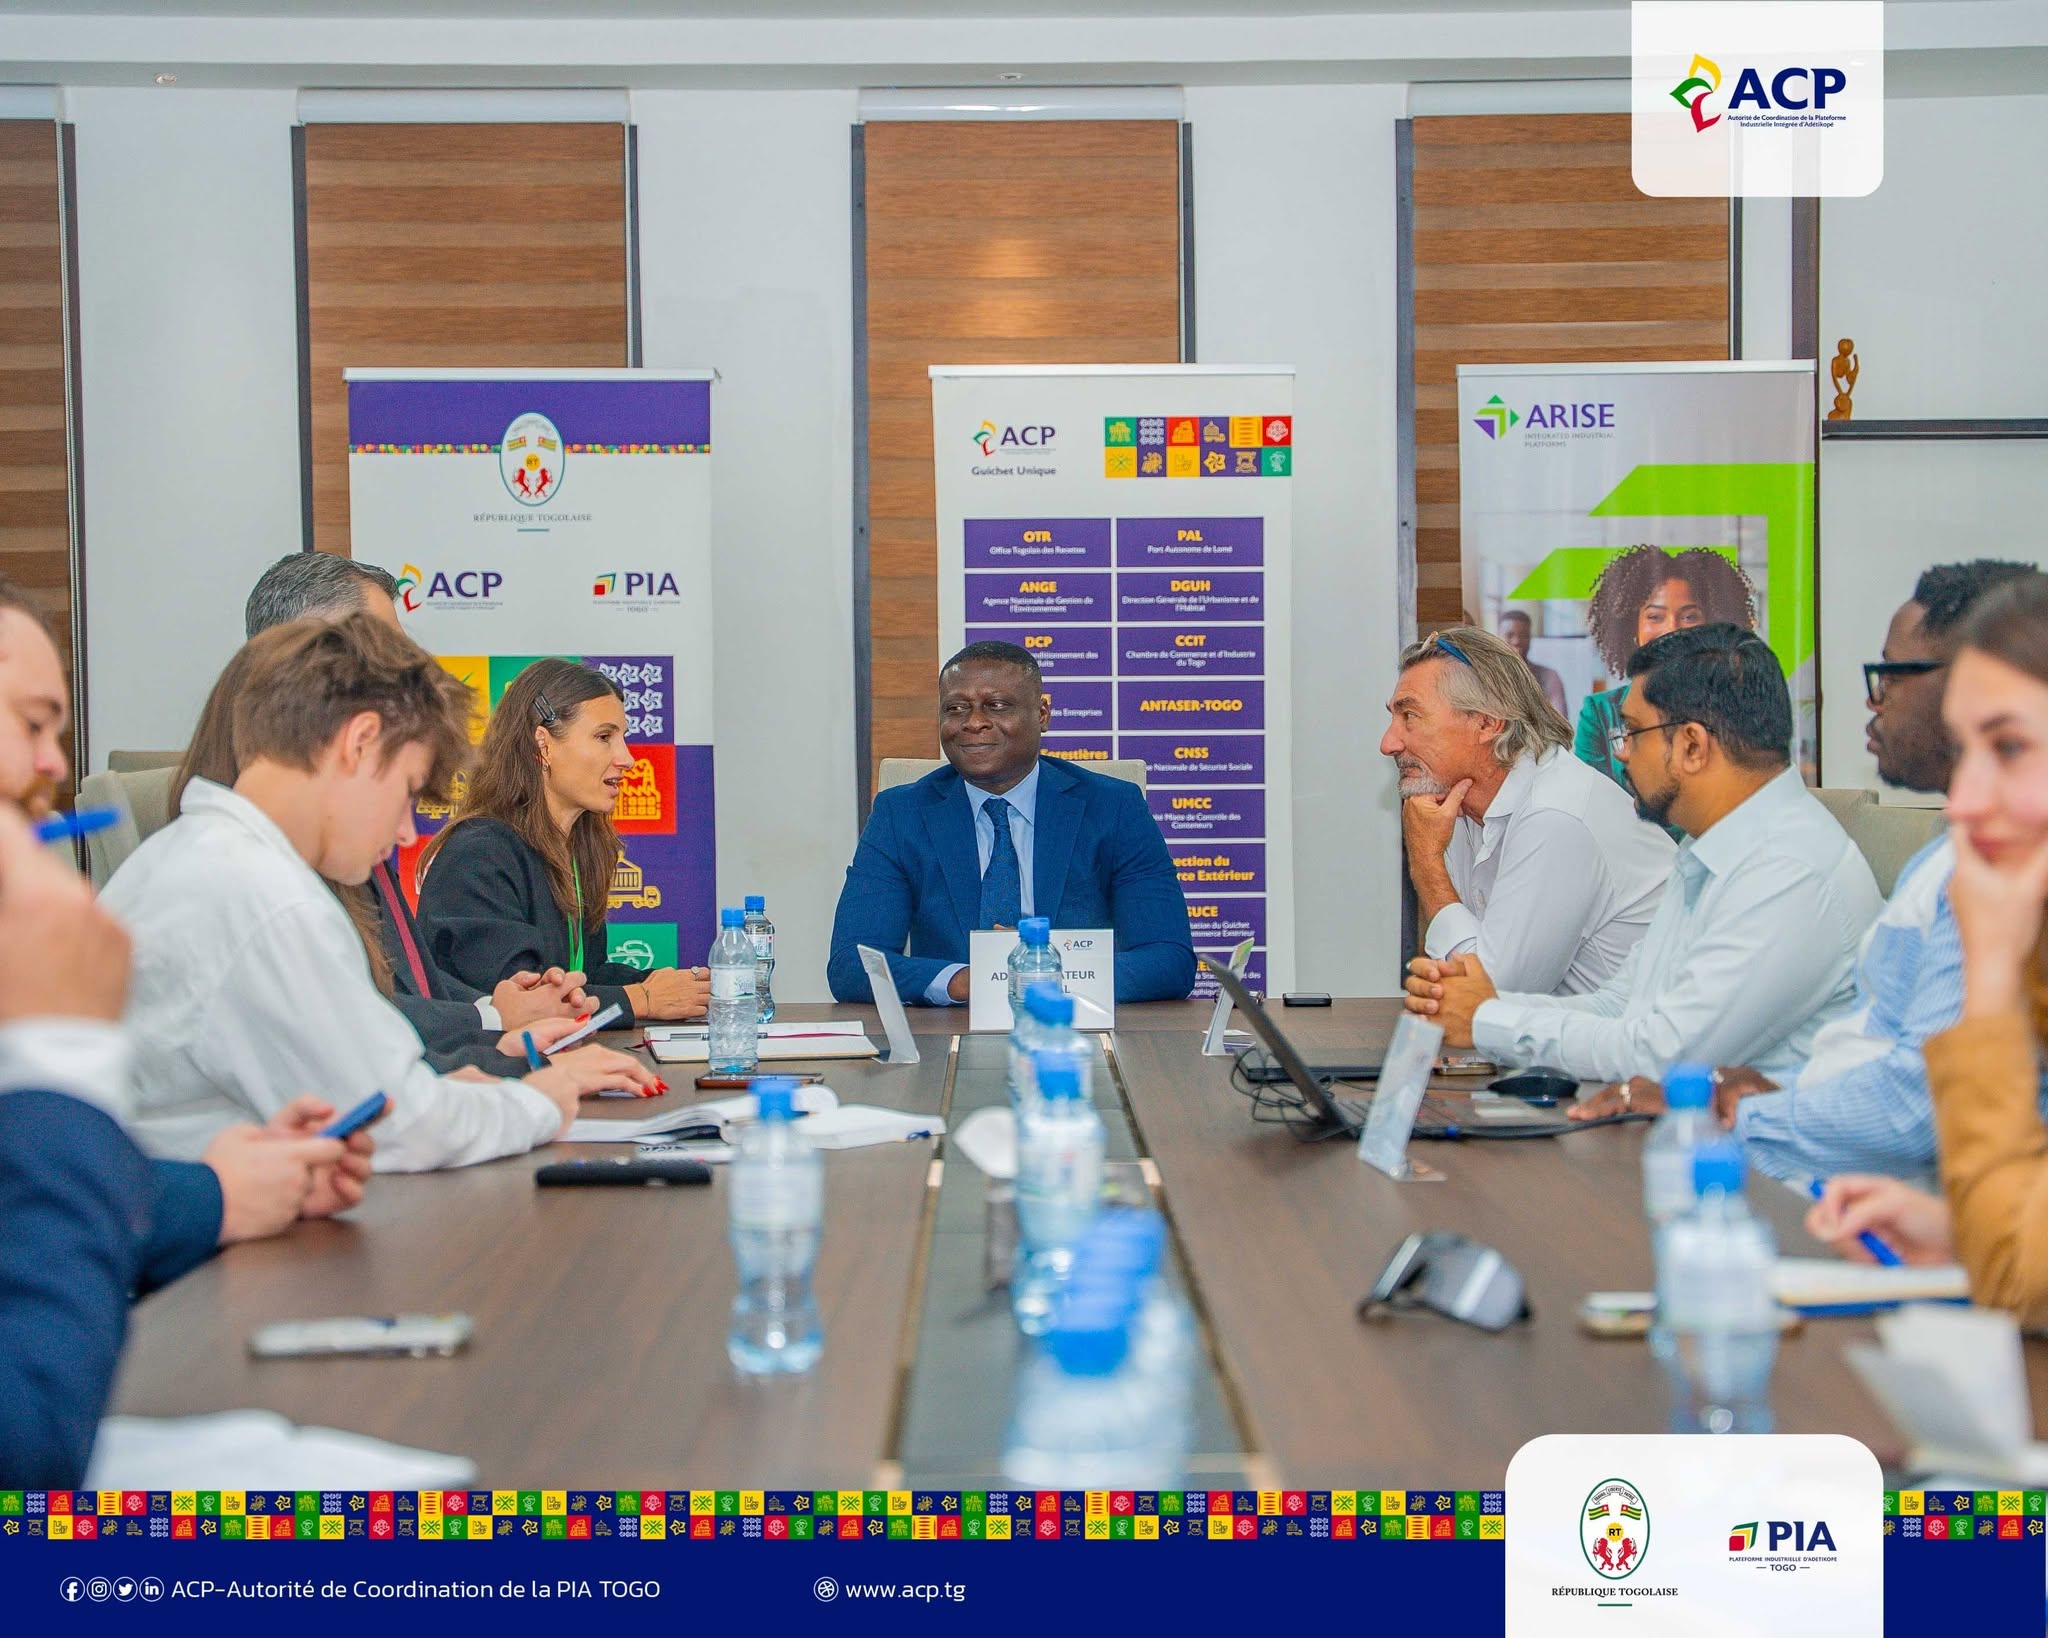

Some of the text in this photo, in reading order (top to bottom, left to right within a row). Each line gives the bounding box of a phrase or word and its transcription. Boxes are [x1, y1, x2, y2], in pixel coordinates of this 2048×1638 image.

[1526, 404, 1615, 428] ARISE
[1001, 426, 1056, 446] ACP
[971, 466, 1056, 477] Guichet Unique
[1023, 531, 1052, 543] OTR
[1177, 530, 1204, 542] PAL
[427, 571, 503, 598] ACP
[625, 572, 679, 596] PIA
[1019, 581, 1057, 593] ANGE
[1170, 580, 1211, 592] DGUH
[1024, 636, 1053, 648] DCP
[1175, 635, 1206, 647] CCIT
[1140, 700, 1243, 712] ANTASER-TOGO
[1174, 747, 1209, 759] CNSS
[1171, 797, 1212, 809] UMCC
[1173, 855, 1230, 867] ection du
[1197, 869, 1255, 881] Extérieur
[1073, 940, 1093, 948] ACP
